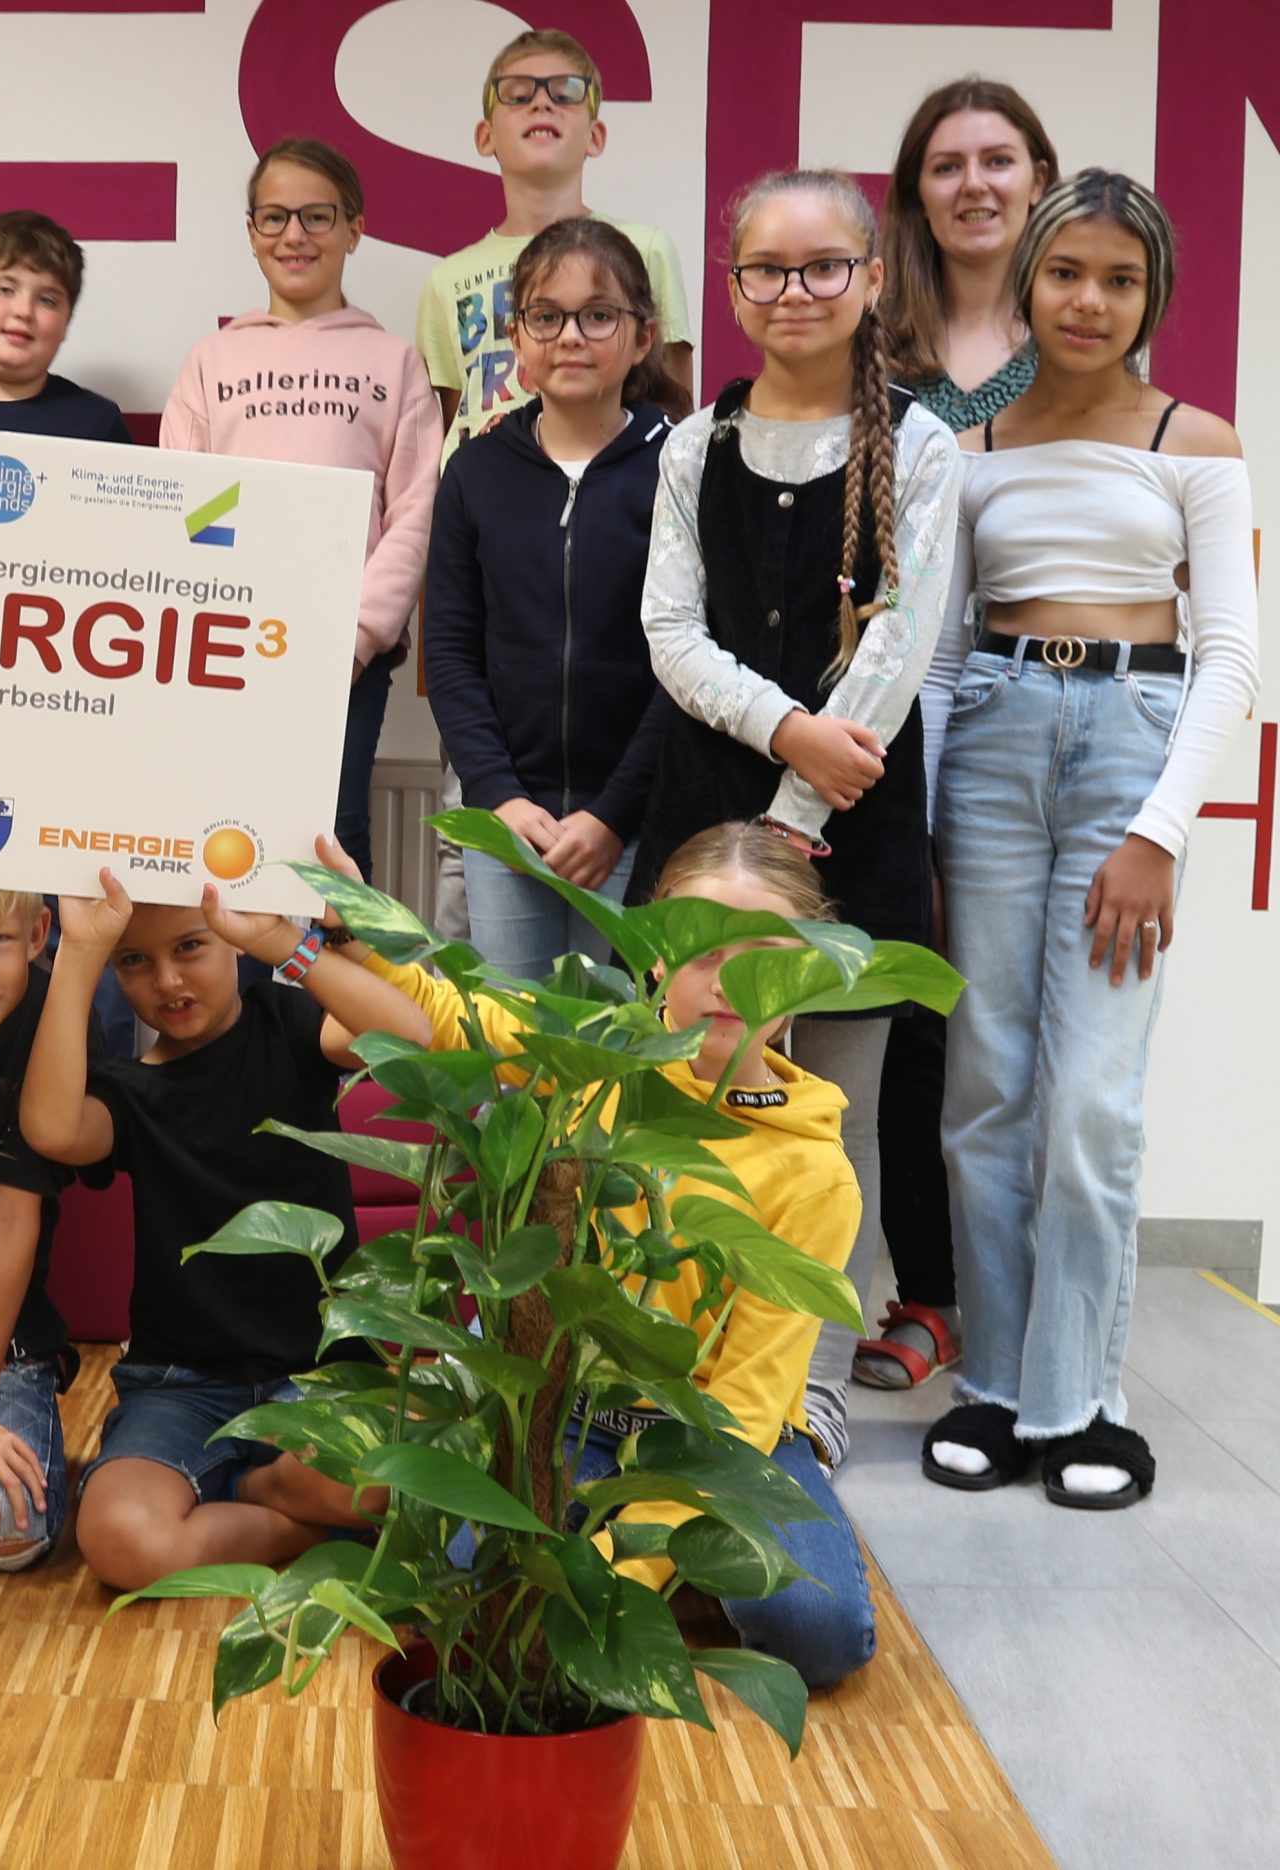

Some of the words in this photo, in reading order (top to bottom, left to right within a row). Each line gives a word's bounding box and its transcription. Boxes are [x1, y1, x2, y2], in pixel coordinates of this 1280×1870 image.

[217, 368, 388, 403] ballerina's
[245, 398, 360, 424] academy
[71, 467, 110, 483] Klima-
[112, 474, 134, 485] und
[136, 475, 184, 491] Energie-
[70, 493, 82, 502] Wir
[84, 495, 117, 505] gestalten
[119, 498, 130, 507] die
[131, 500, 182, 512] Energiewende
[96, 482, 184, 502] Modellregionen
[203, 819, 239, 836] BRUCK
[243, 823, 257, 837] AN
[38, 826, 195, 860] ENERGIE
[256, 838, 265, 862] DER
[129, 856, 193, 876] PARK
[229, 863, 262, 890] LEITHA
